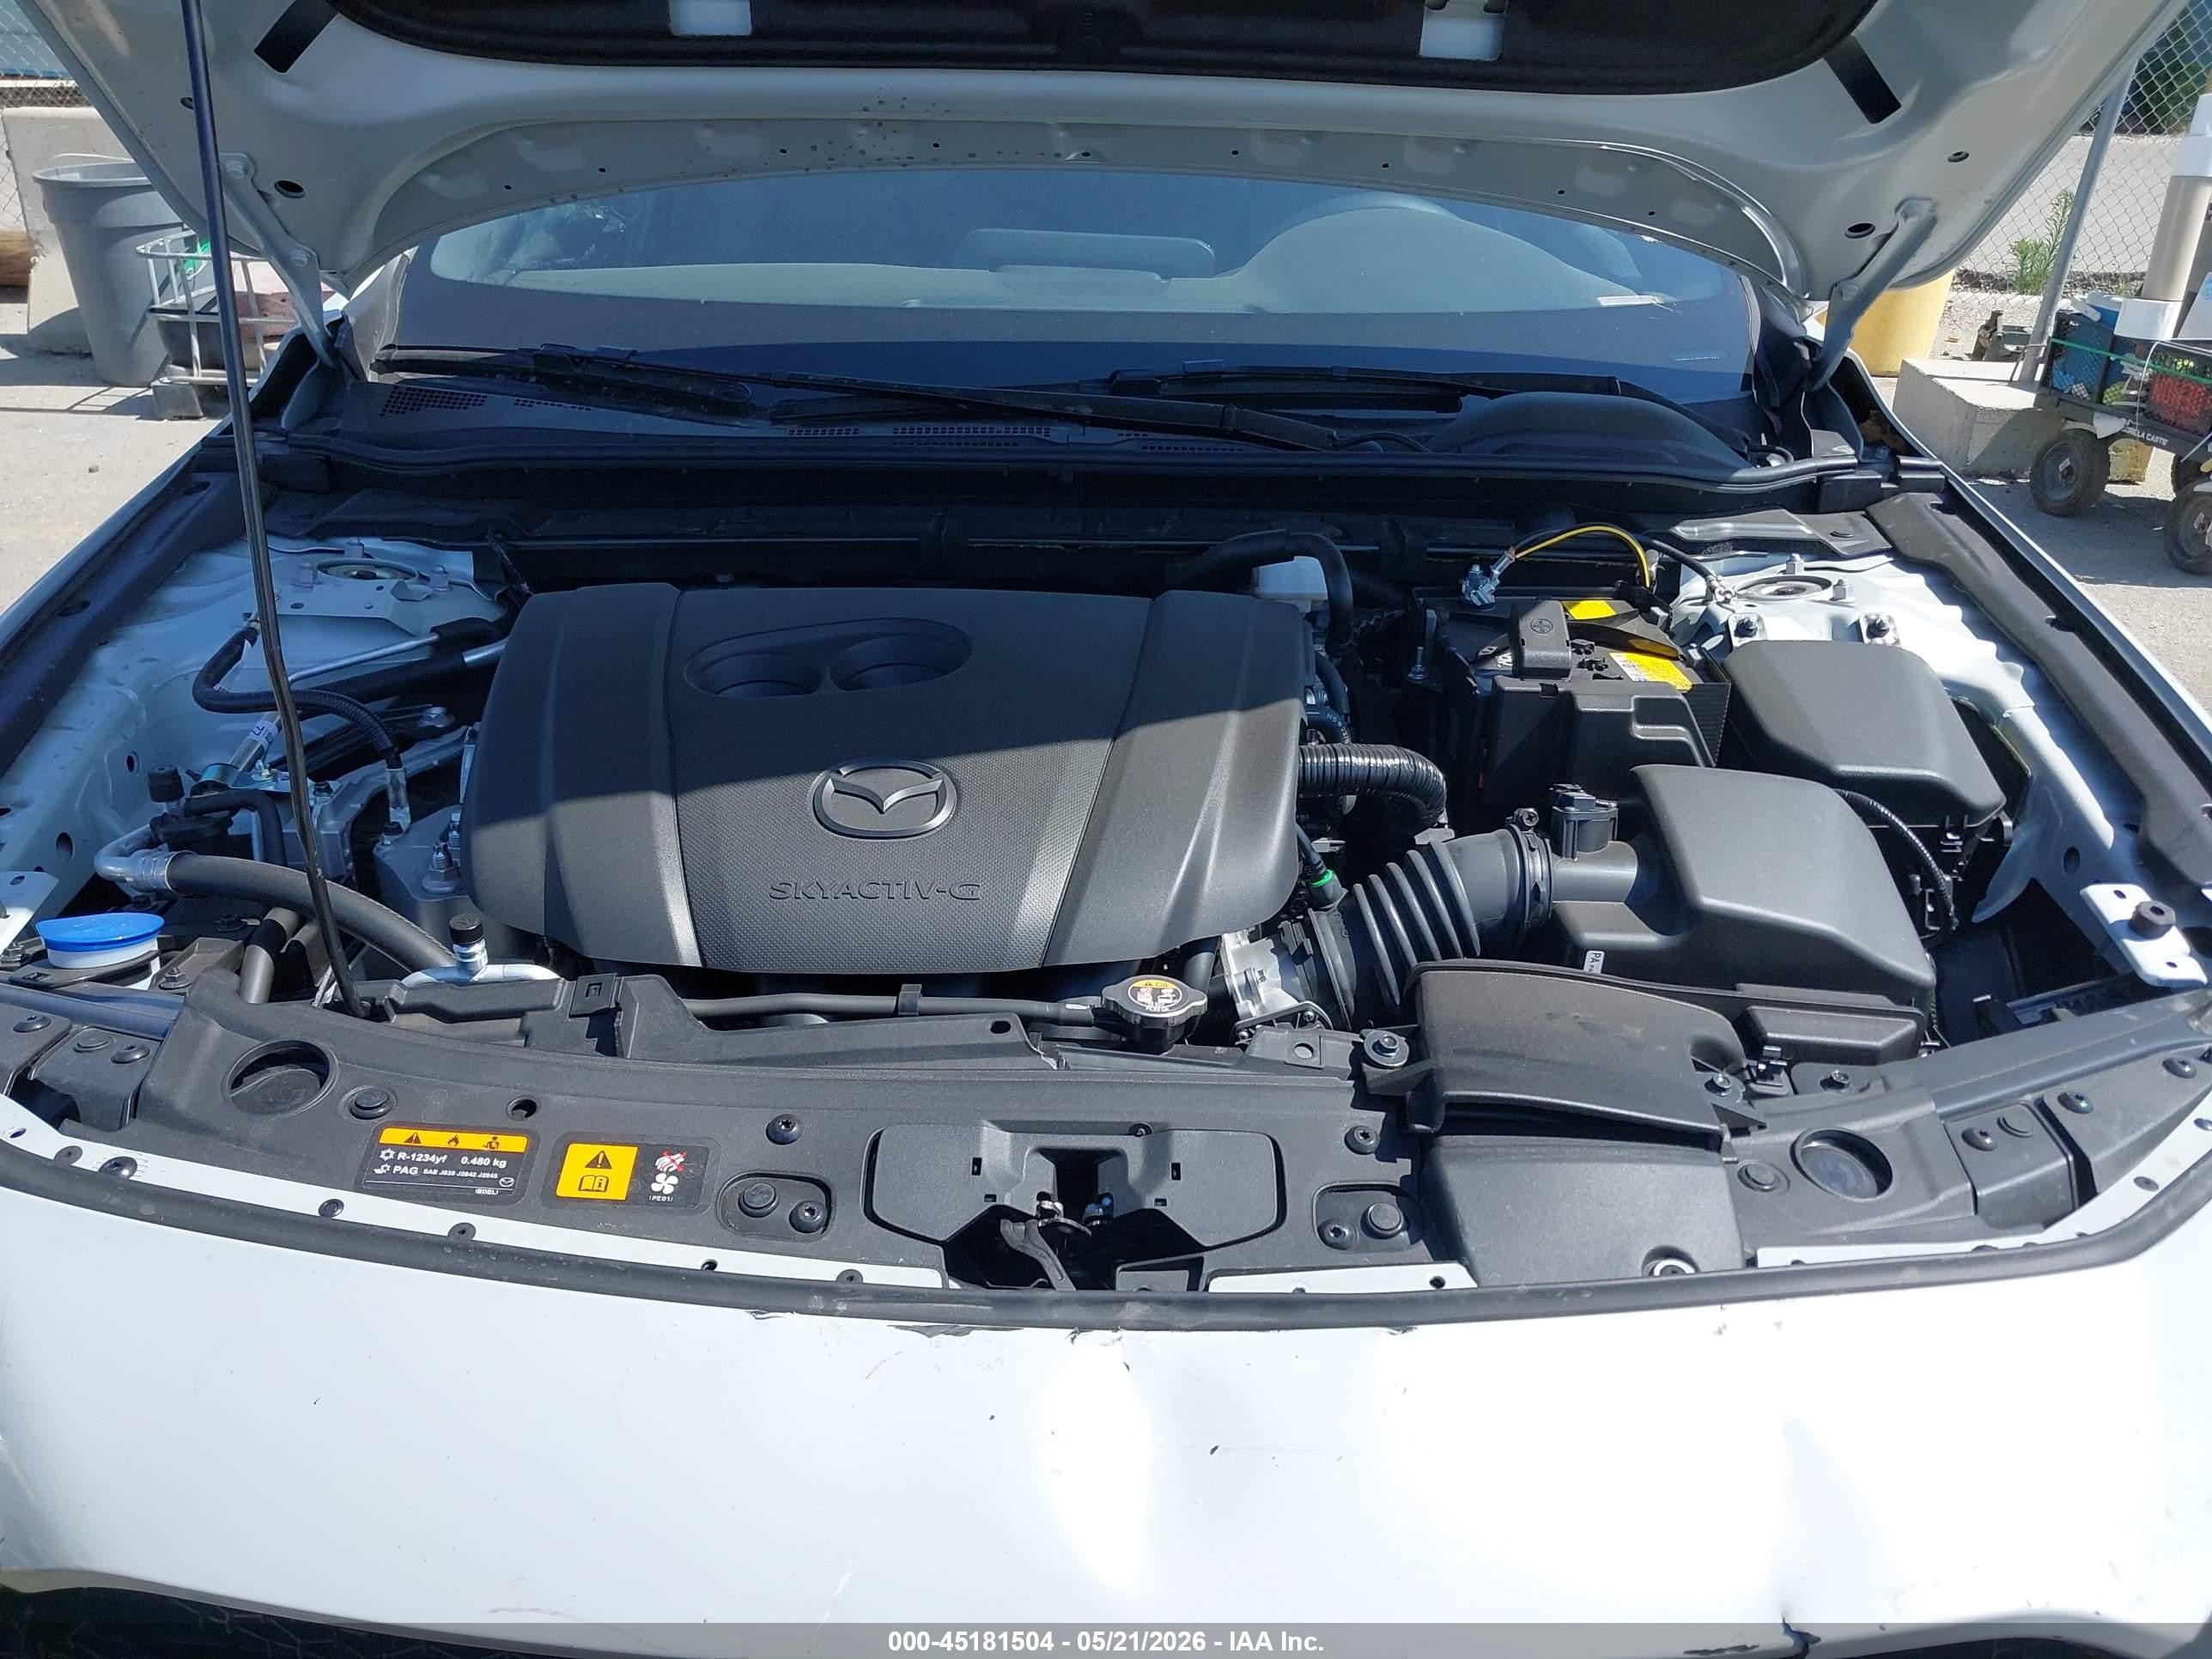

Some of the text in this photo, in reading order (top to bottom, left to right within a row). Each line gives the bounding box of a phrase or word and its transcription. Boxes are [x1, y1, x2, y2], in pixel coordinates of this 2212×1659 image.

[769, 880, 982, 901] SKYACTIV-G
[398, 1152, 507, 1169] R-1234yf 0.480 kg
[392, 1165, 419, 1176] PAG
